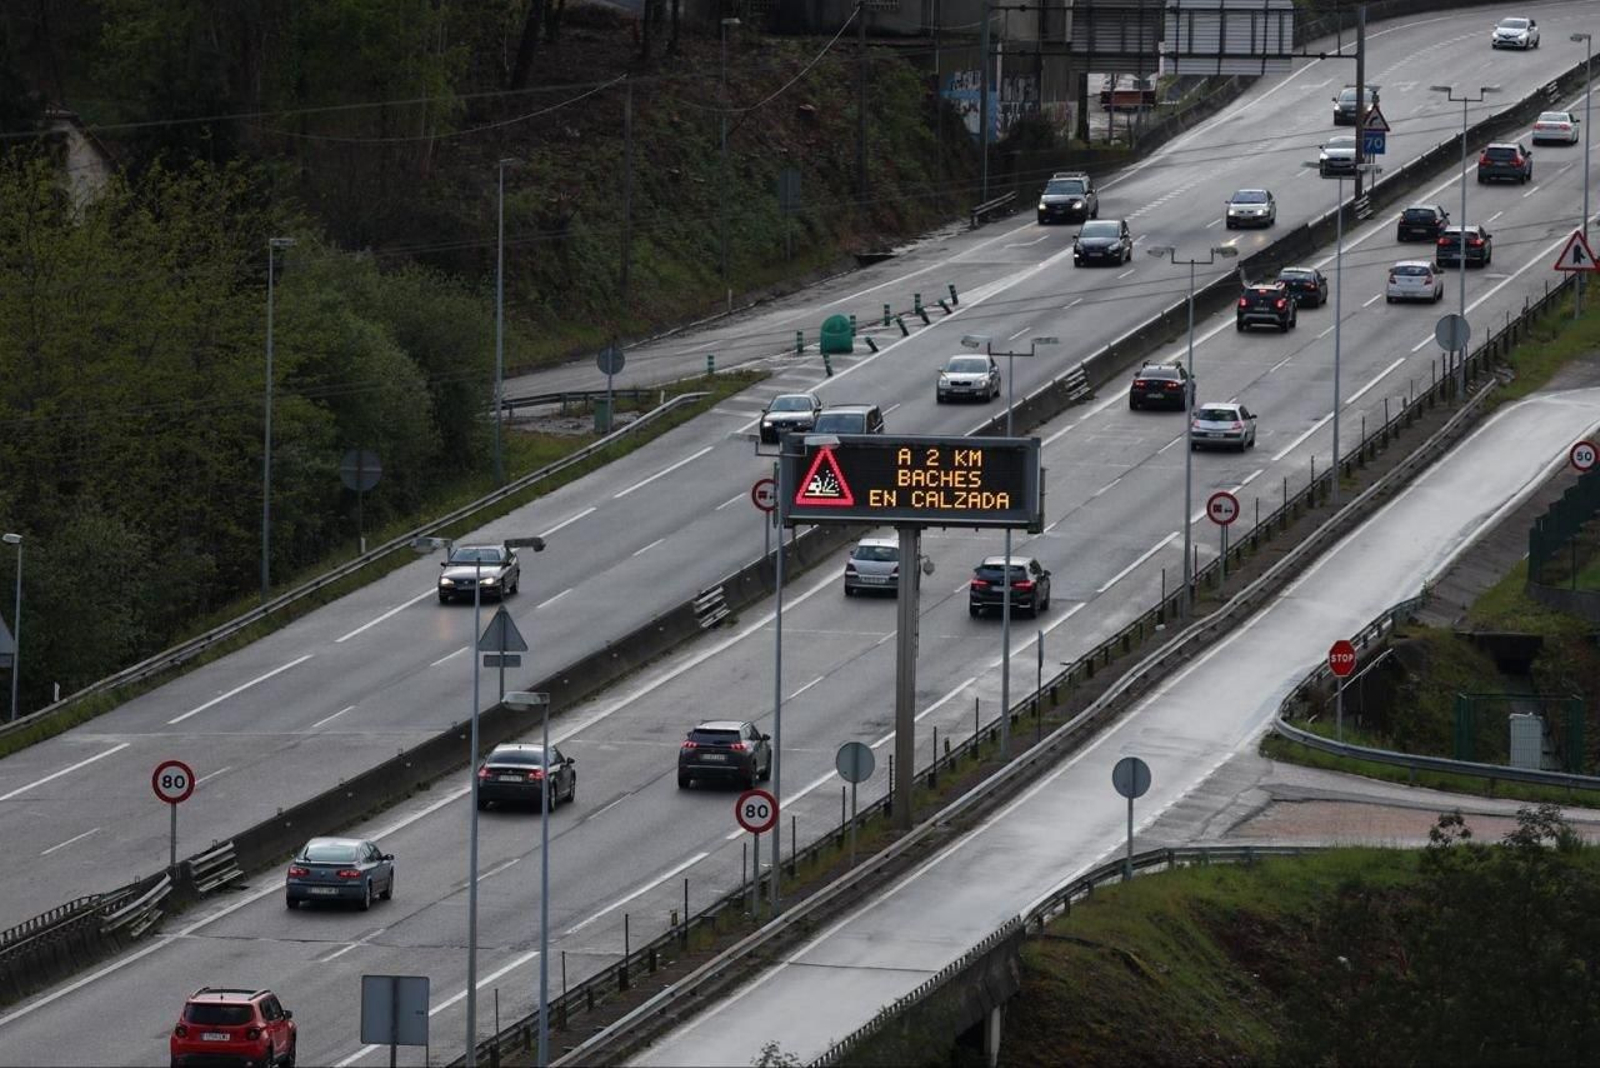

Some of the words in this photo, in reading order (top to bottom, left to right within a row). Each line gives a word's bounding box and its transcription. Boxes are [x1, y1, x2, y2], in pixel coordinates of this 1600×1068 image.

[1365, 136, 1384, 150] 70
[898, 448, 911, 466] A
[926, 449, 940, 467] 2
[954, 450, 982, 467] KM
[1576, 451, 1592, 461] 50
[897, 469, 982, 488] BACHES
[869, 489, 897, 507] EN
[911, 491, 1010, 509] CALZADA
[1331, 653, 1354, 663] STOP
[162, 774, 185, 789] 80
[745, 804, 769, 819] 80
